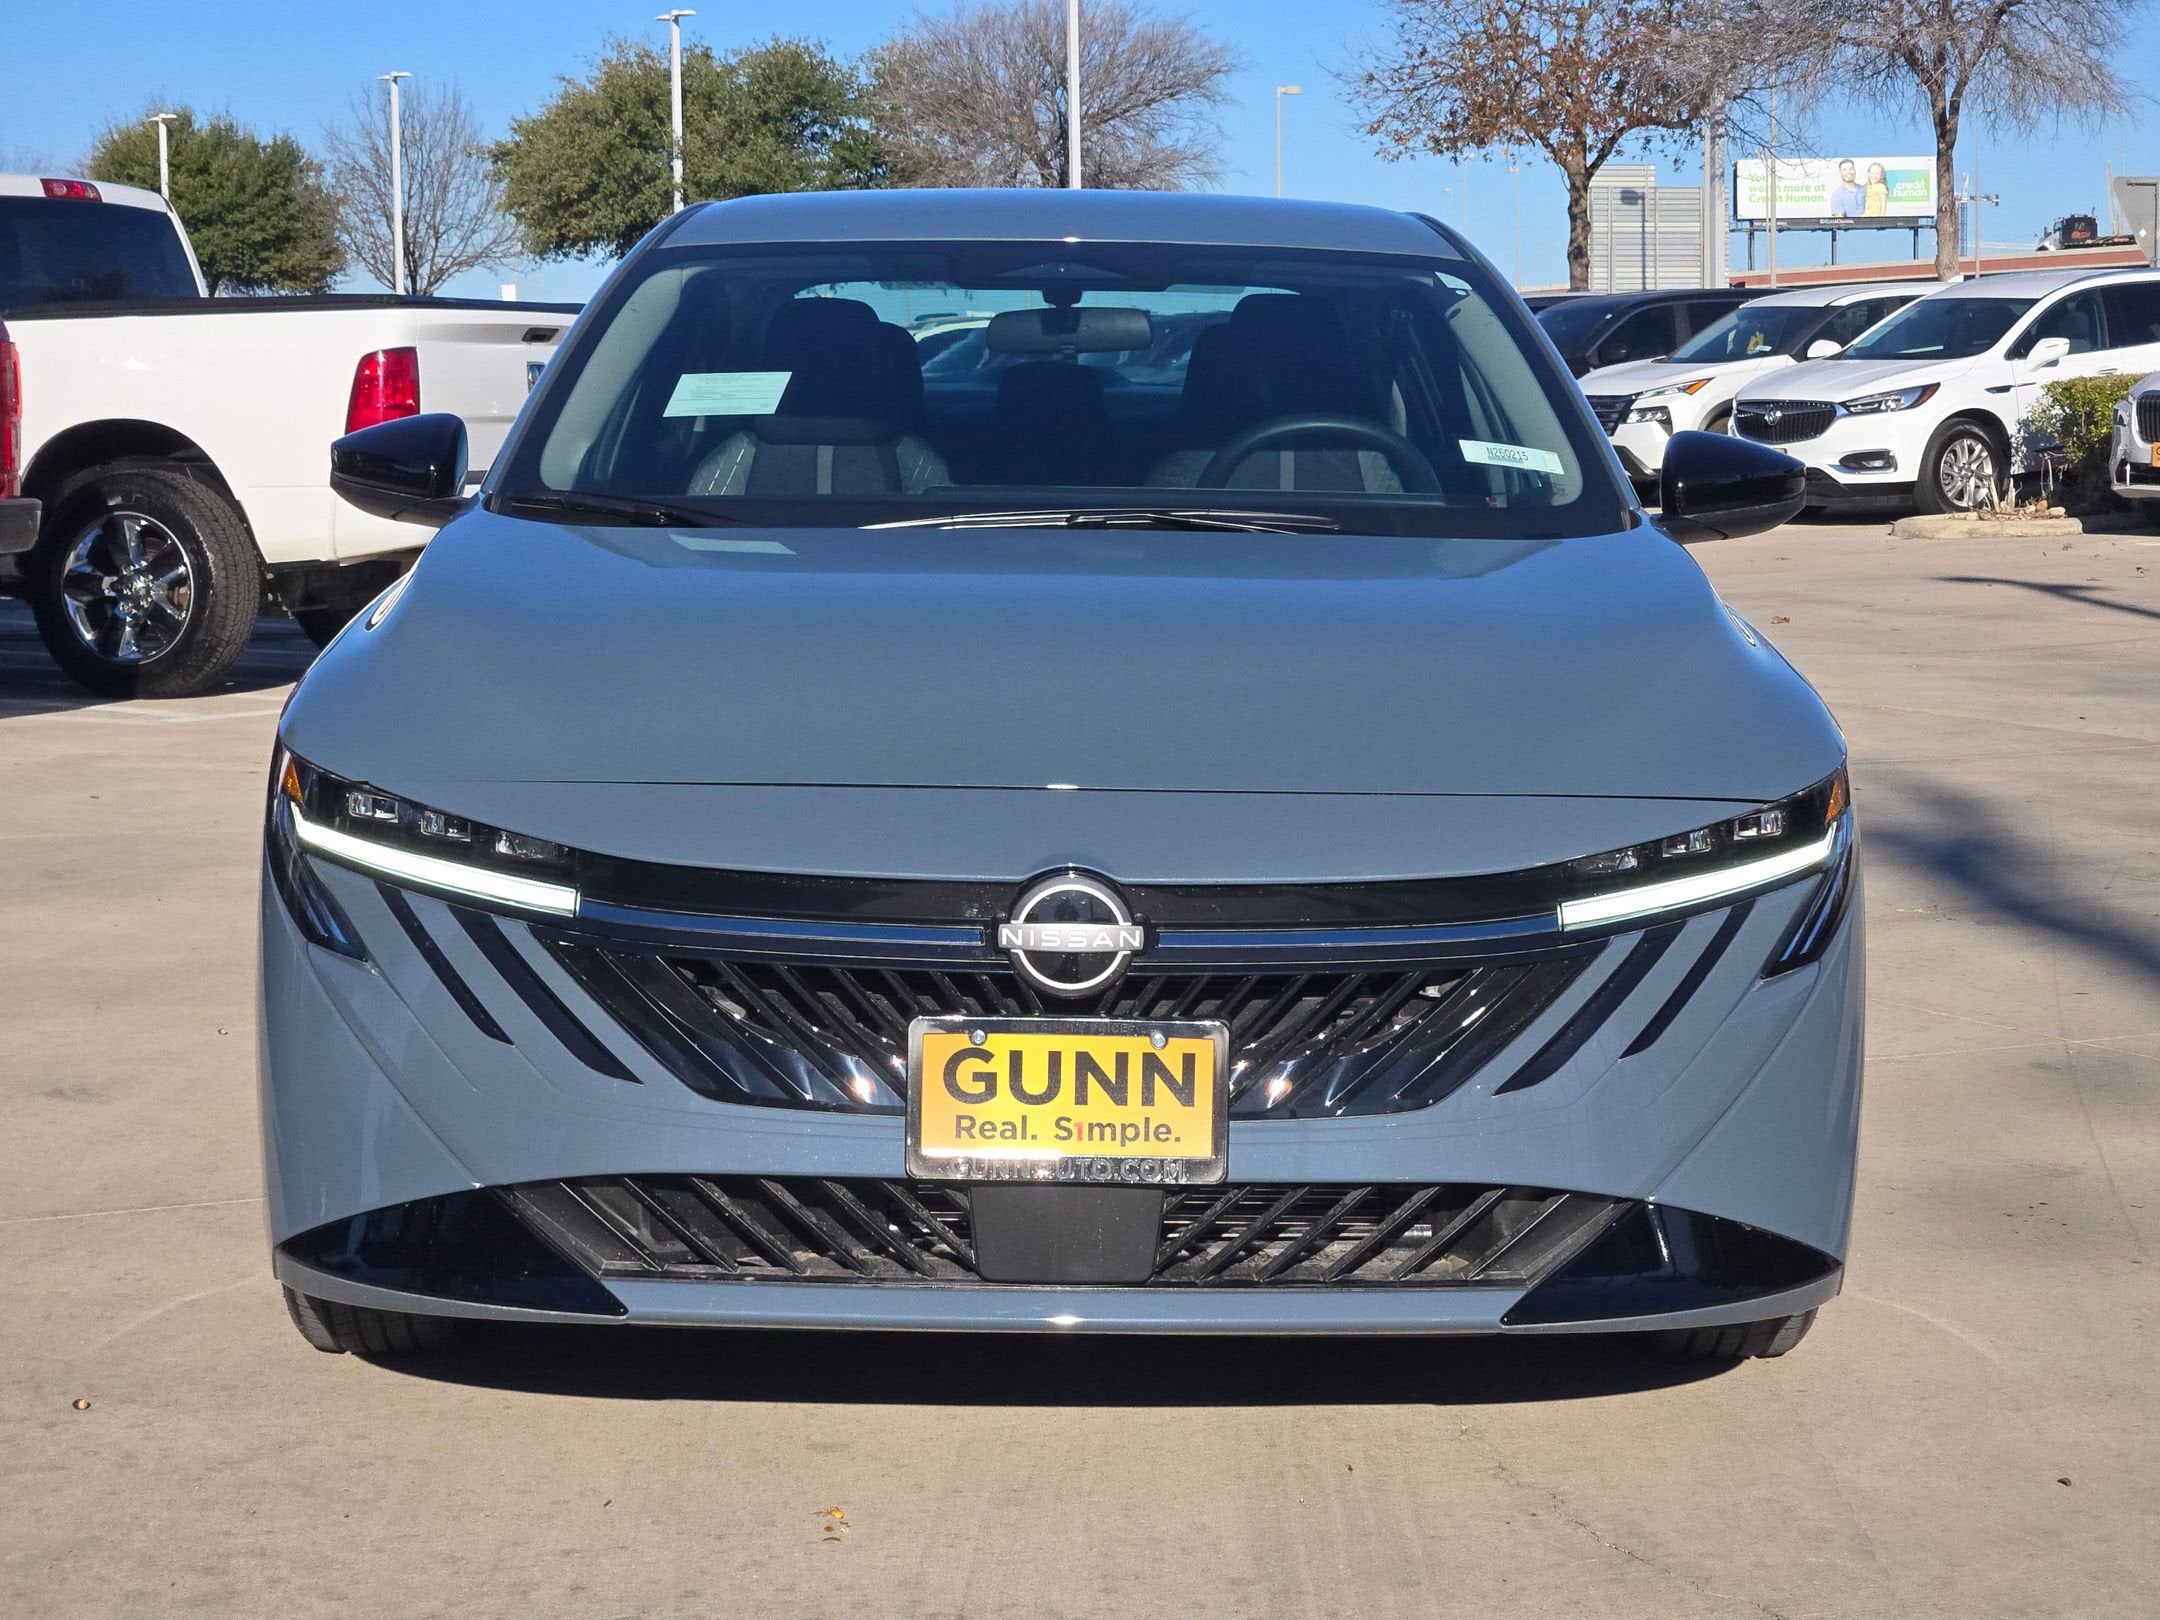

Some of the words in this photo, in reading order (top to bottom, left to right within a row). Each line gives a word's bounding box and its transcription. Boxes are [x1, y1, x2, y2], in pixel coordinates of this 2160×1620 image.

[1783, 184, 1812, 193] more
[1814, 183, 1826, 192] at
[1896, 179, 1925, 190] credit
[1785, 193, 1828, 203] Human.
[1893, 187, 1928, 198] human
[1486, 447, 1529, 461] N260215
[1001, 927, 1141, 948] NISSAN
[943, 1047, 1196, 1108] GUNN
[955, 1114, 1038, 1141] Real.
[950, 1157, 1187, 1184] GUNNUTO.COM
